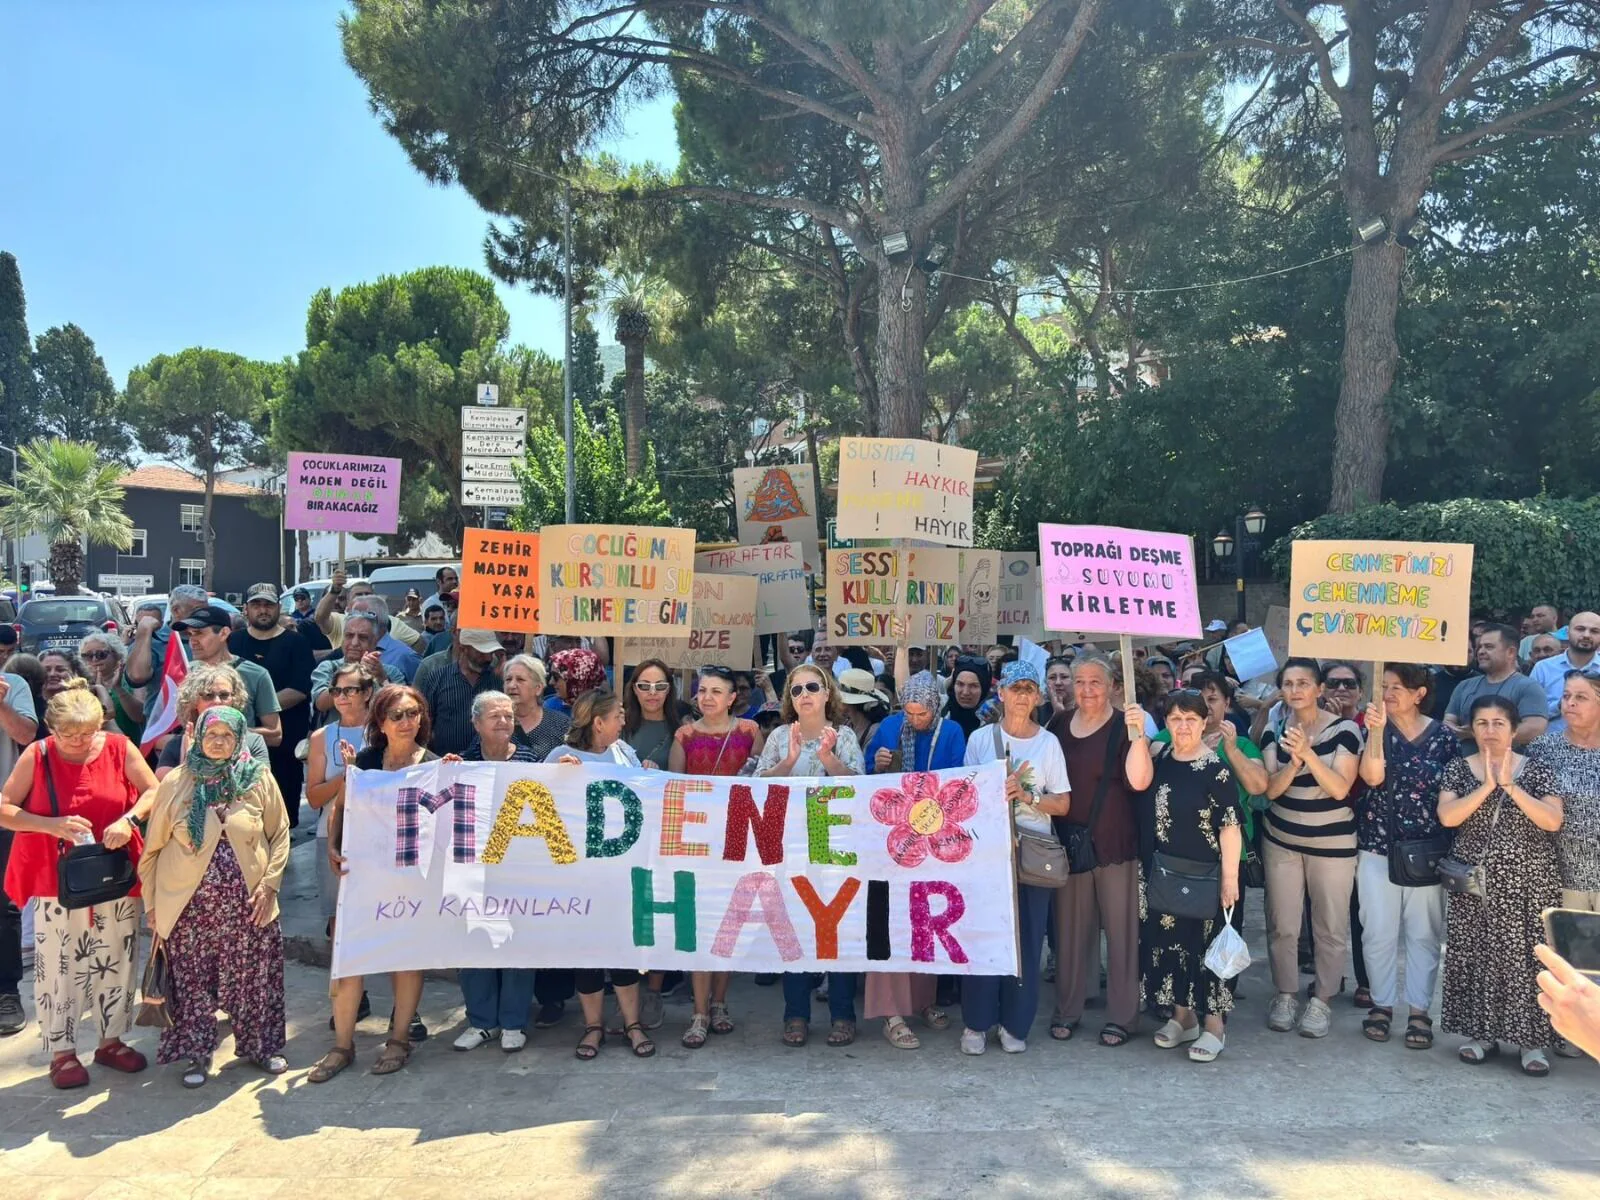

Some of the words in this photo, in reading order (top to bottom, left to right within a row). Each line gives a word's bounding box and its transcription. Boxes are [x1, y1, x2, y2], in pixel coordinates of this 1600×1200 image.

[302, 460, 386, 473] ÇOCUKLARIMIZA
[300, 475, 342, 486] MADEN
[351, 477, 388, 489] DEĞİL
[904, 471, 971, 497] HAYKIR
[307, 500, 378, 513] BIRAKACAĞIZ
[915, 516, 971, 541] HAYIR
[480, 540, 531, 557] ZEHİR
[568, 532, 681, 561] ÇOCUĞUMA
[704, 544, 797, 568] TARAFTAR
[1050, 540, 1122, 560] TOPRAĞI
[1129, 548, 1182, 566] DEŞME
[474, 561, 528, 577] MADEN
[1326, 551, 1454, 577] CENNETİMİZİ
[492, 583, 535, 599] YAŞA
[664, 566, 692, 595] SU
[1082, 568, 1173, 589] SUYUMU
[1060, 591, 1177, 619] KİRLETME
[1302, 581, 1431, 608] CEHENNEME
[925, 612, 955, 640] BİZ
[395, 778, 858, 867] MADENE
[375, 896, 423, 921] KÖY
[438, 896, 592, 918] KADINLARI
[631, 867, 969, 964] HAYIR
